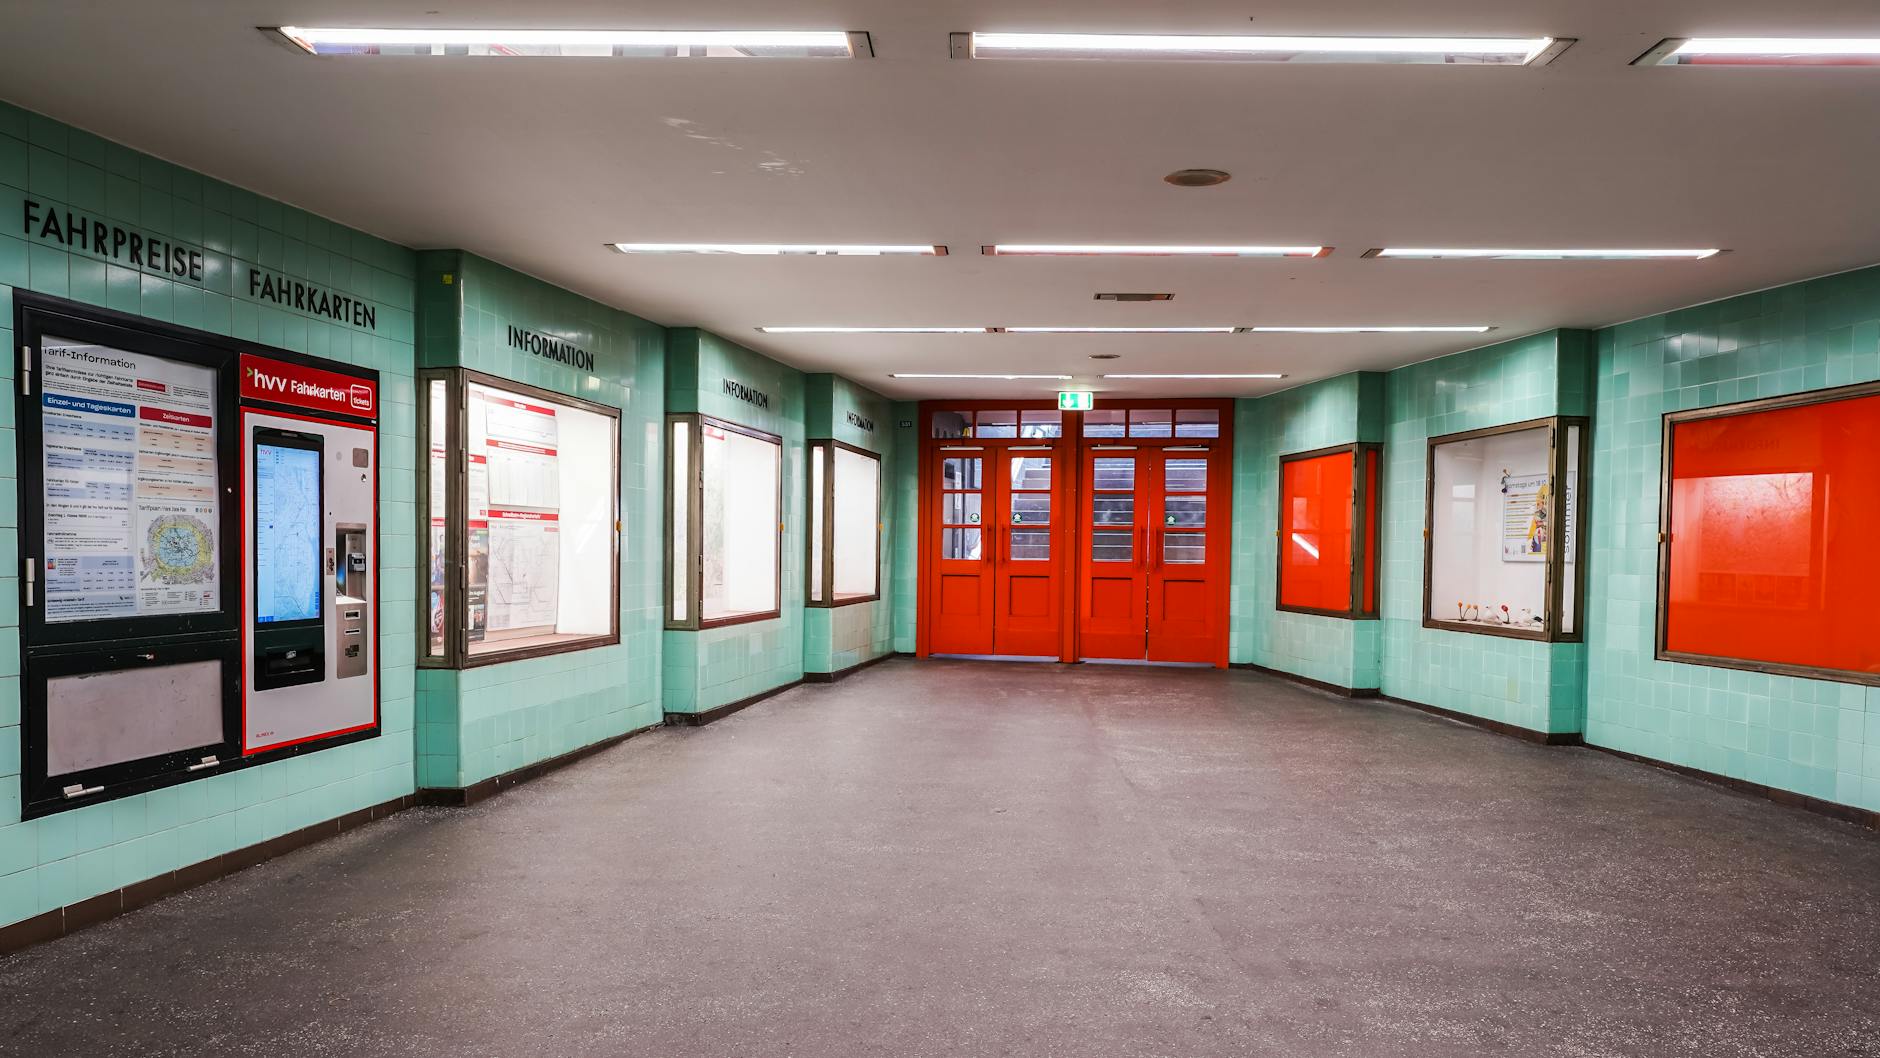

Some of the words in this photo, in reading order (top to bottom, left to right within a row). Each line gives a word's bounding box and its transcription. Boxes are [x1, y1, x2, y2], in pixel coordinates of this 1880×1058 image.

[24, 200, 202, 281] FAHRPREISE
[249, 268, 376, 330] FAHRKARTEN
[508, 325, 594, 372] INFORMATION
[254, 368, 287, 393] hvv
[291, 380, 346, 402] Fahrkarten
[722, 378, 769, 409] INFORMATION
[47, 397, 71, 406] Einzel-
[72, 400, 86, 408] und
[87, 402, 132, 414] Tageskarten
[162, 412, 190, 423] Zeitkarten
[846, 410, 874, 432] INFORMATION
